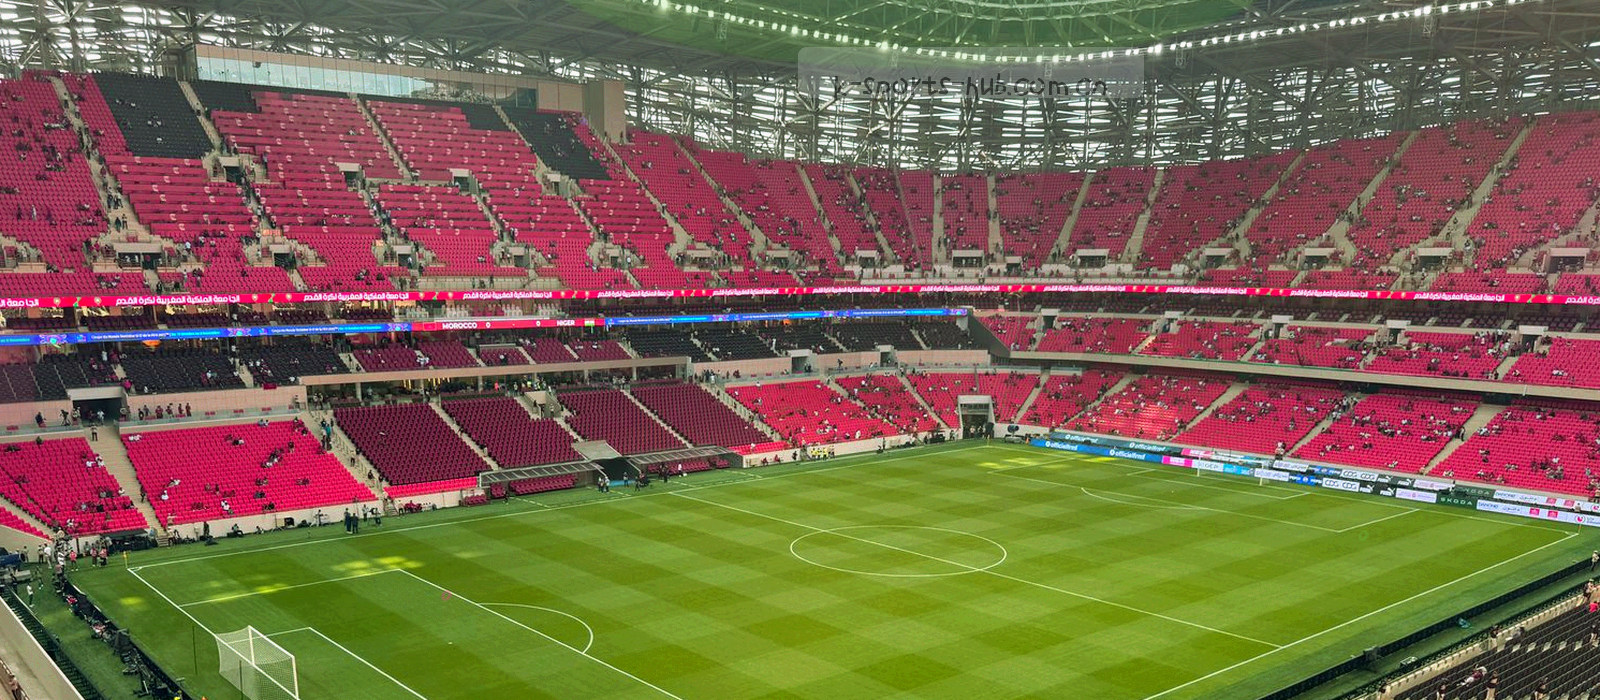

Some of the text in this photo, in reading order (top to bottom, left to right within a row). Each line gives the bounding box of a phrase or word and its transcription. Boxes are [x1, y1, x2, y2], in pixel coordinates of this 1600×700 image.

[138, 296, 155, 305] لكرة
[156, 295, 186, 305] المغربية
[187, 295, 212, 304] الملكية
[303, 294, 322, 302] القدم
[323, 293, 338, 301] لكرة
[338, 292, 363, 301] المغربية
[363, 292, 385, 300] الملكية
[116, 297, 138, 306] القدم
[1325, 479, 1357, 490] CDG CDG
